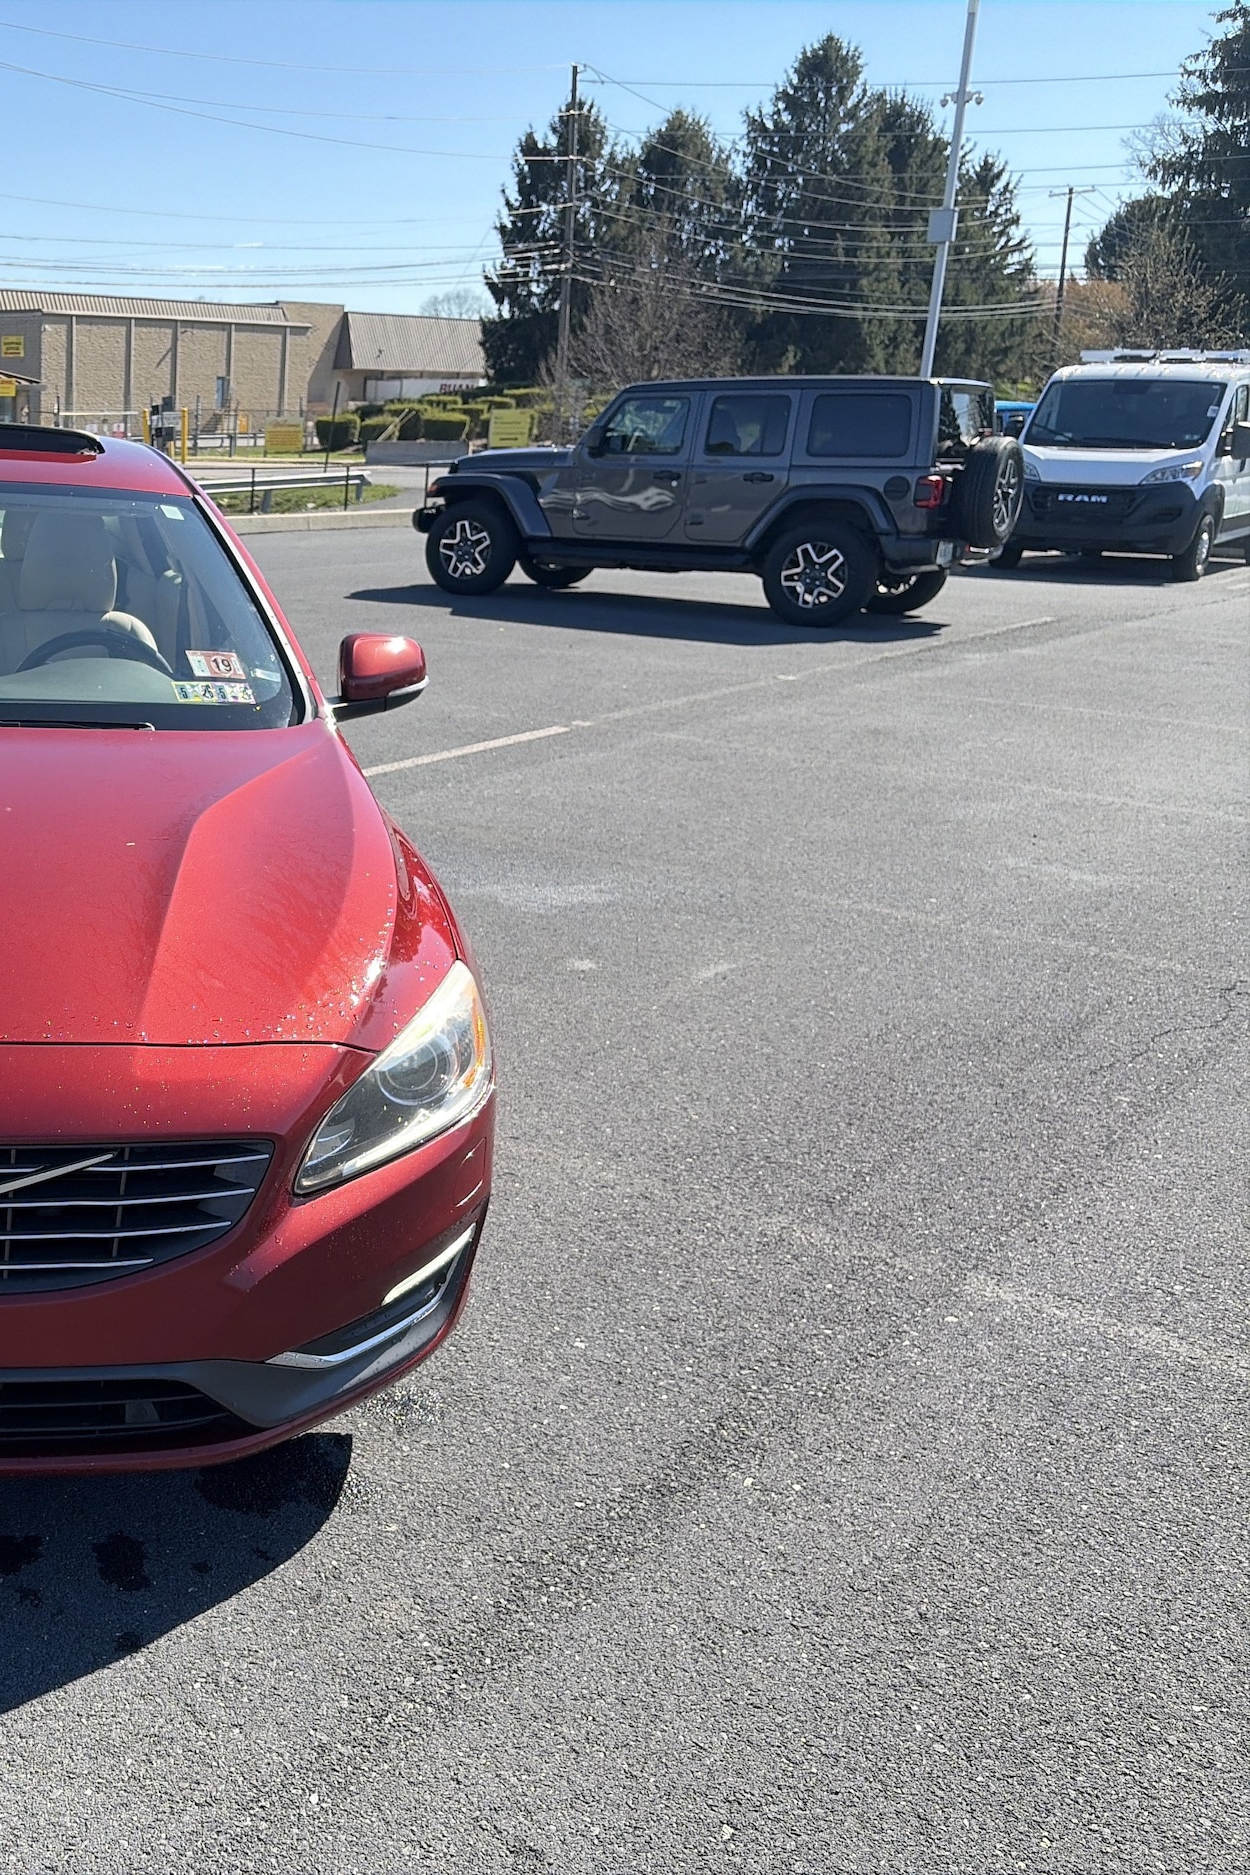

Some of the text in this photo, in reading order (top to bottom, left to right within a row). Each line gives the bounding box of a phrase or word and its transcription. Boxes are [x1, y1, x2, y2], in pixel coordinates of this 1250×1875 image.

[1058, 494, 1107, 502] RAM
[212, 658, 232, 672] 19
[180, 687, 188, 699] 5
[219, 687, 227, 699] 5
